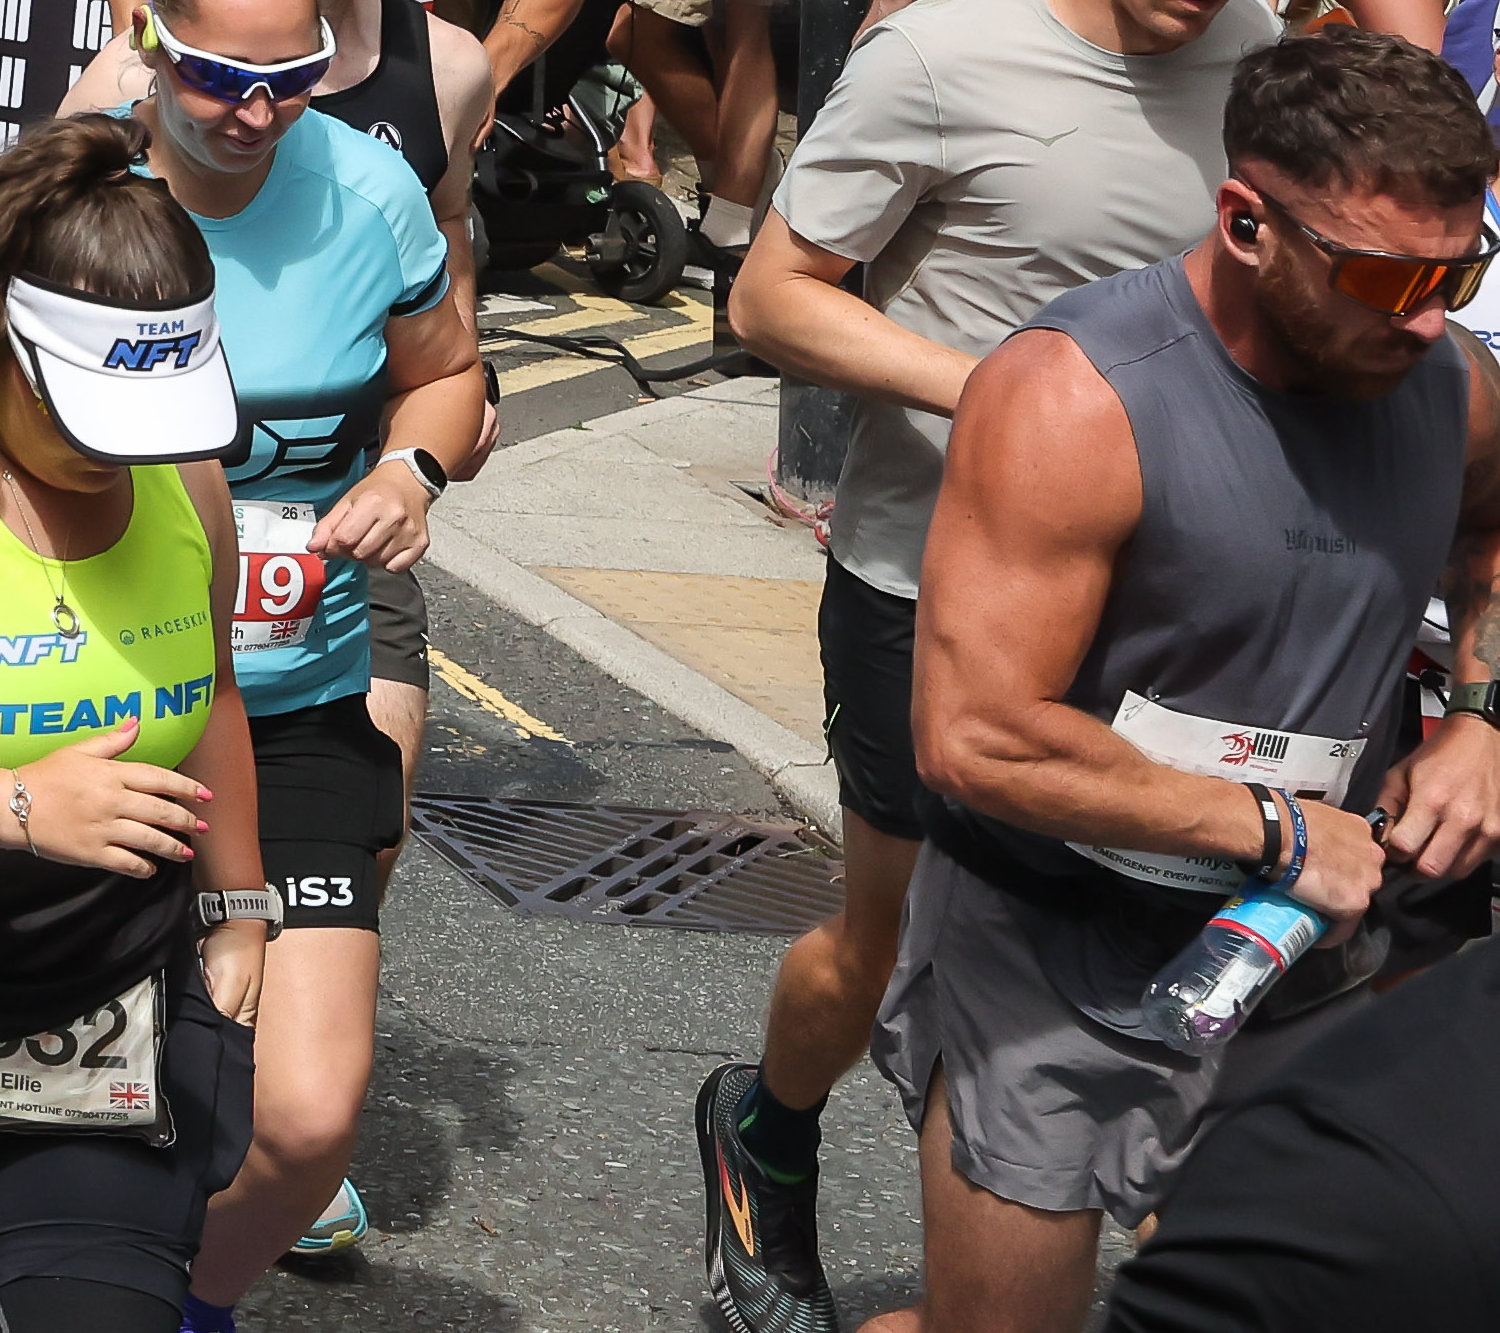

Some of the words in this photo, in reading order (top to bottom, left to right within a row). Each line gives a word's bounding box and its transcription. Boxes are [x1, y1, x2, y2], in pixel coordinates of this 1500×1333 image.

[136, 319, 185, 337] TEAM
[102, 329, 203, 372] NFT
[282, 506, 299, 521] 26
[154, 674, 214, 719] NFT
[1163, 869, 1197, 885] EVENT
[285, 876, 354, 908] iS3
[0, 1072, 42, 1093] Ellie
[16, 1103, 62, 1117] HOTLINE
